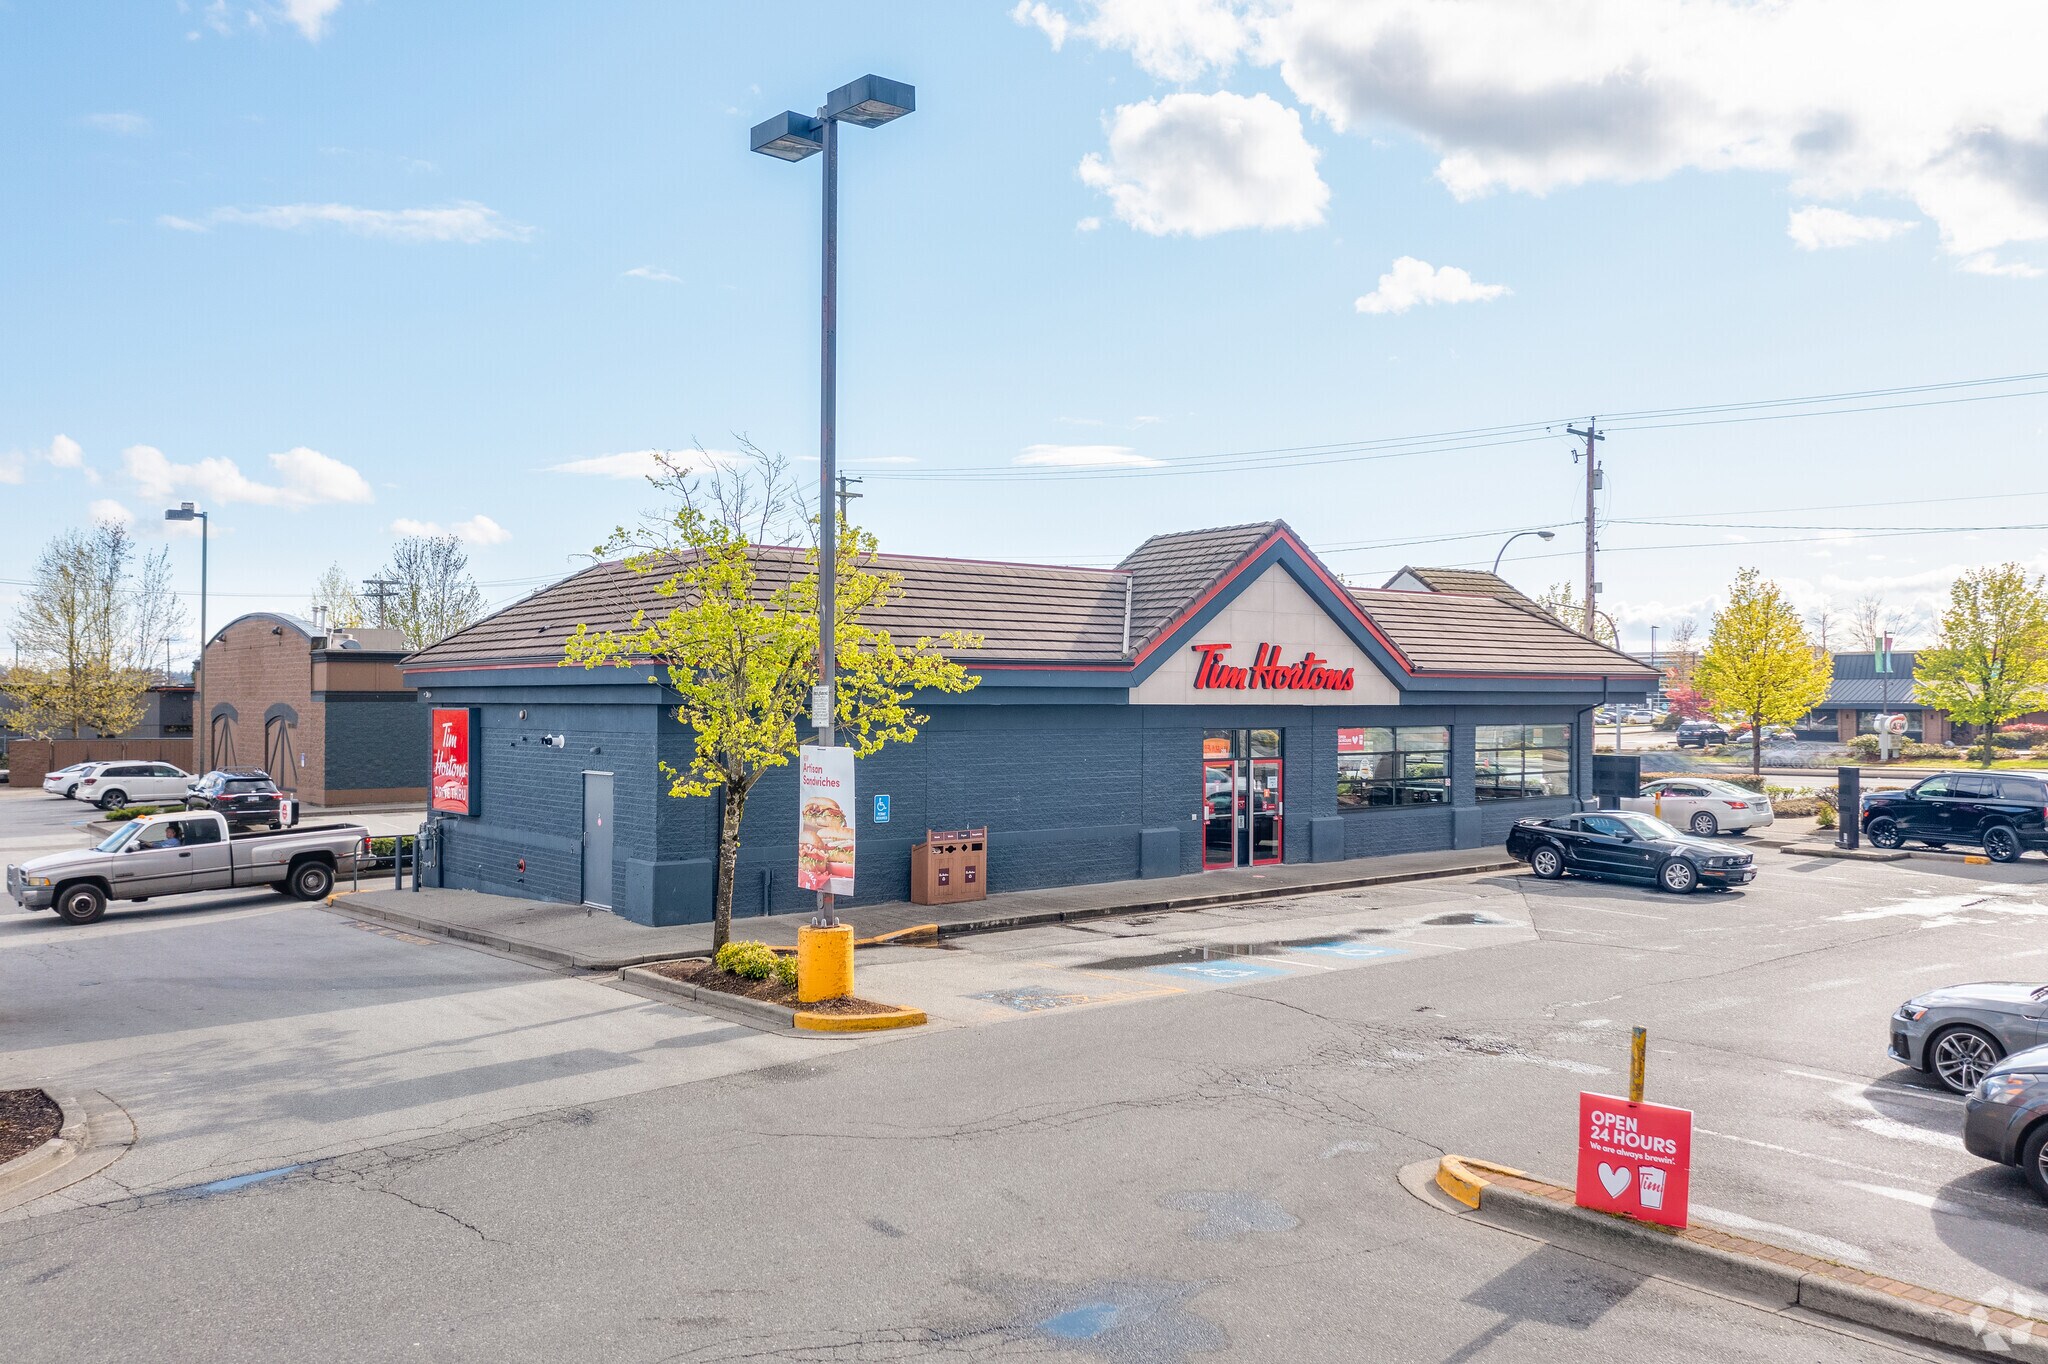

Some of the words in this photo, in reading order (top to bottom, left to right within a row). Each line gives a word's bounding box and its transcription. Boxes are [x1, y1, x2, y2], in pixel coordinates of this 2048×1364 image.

[1191, 643, 1248, 690] Tim
[1249, 642, 1355, 691] Hortons
[442, 722, 457, 748] Tim
[435, 750, 467, 777] Hortons
[803, 762, 823, 774] Artisan
[803, 774, 841, 788] Sandwiches
[1591, 1110, 1638, 1133] OPEN
[1590, 1125, 1611, 1142] 24
[1613, 1129, 1677, 1155] HOURS
[1590, 1141, 1602, 1151] We
[1602, 1145, 1616, 1154] are
[1616, 1148, 1643, 1161] always
